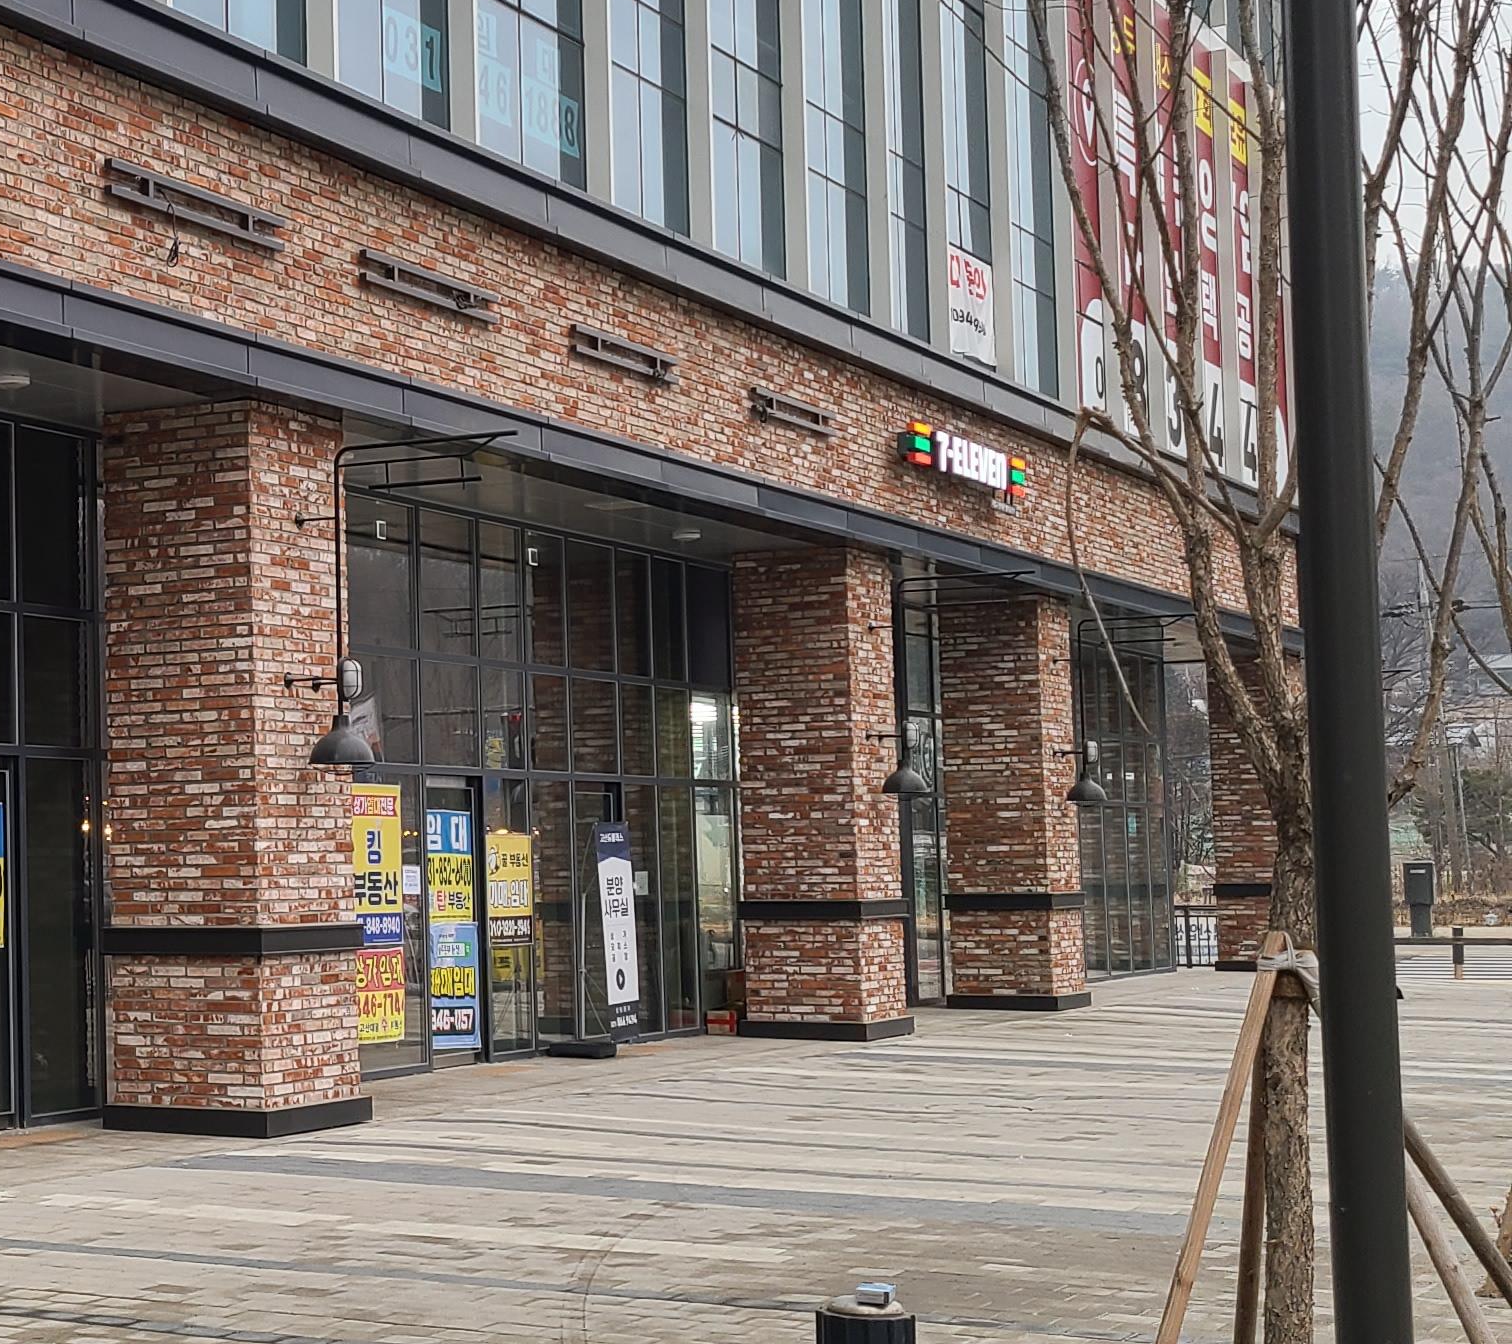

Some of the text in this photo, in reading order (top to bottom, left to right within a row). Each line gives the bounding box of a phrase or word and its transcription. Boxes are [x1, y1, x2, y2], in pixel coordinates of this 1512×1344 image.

[385, 15, 435, 81] 031
[367, 831, 381, 864] 킹
[354, 871, 398, 906] 부동산
[606, 876, 624, 896] 분양
[604, 897, 629, 918] 사무실
